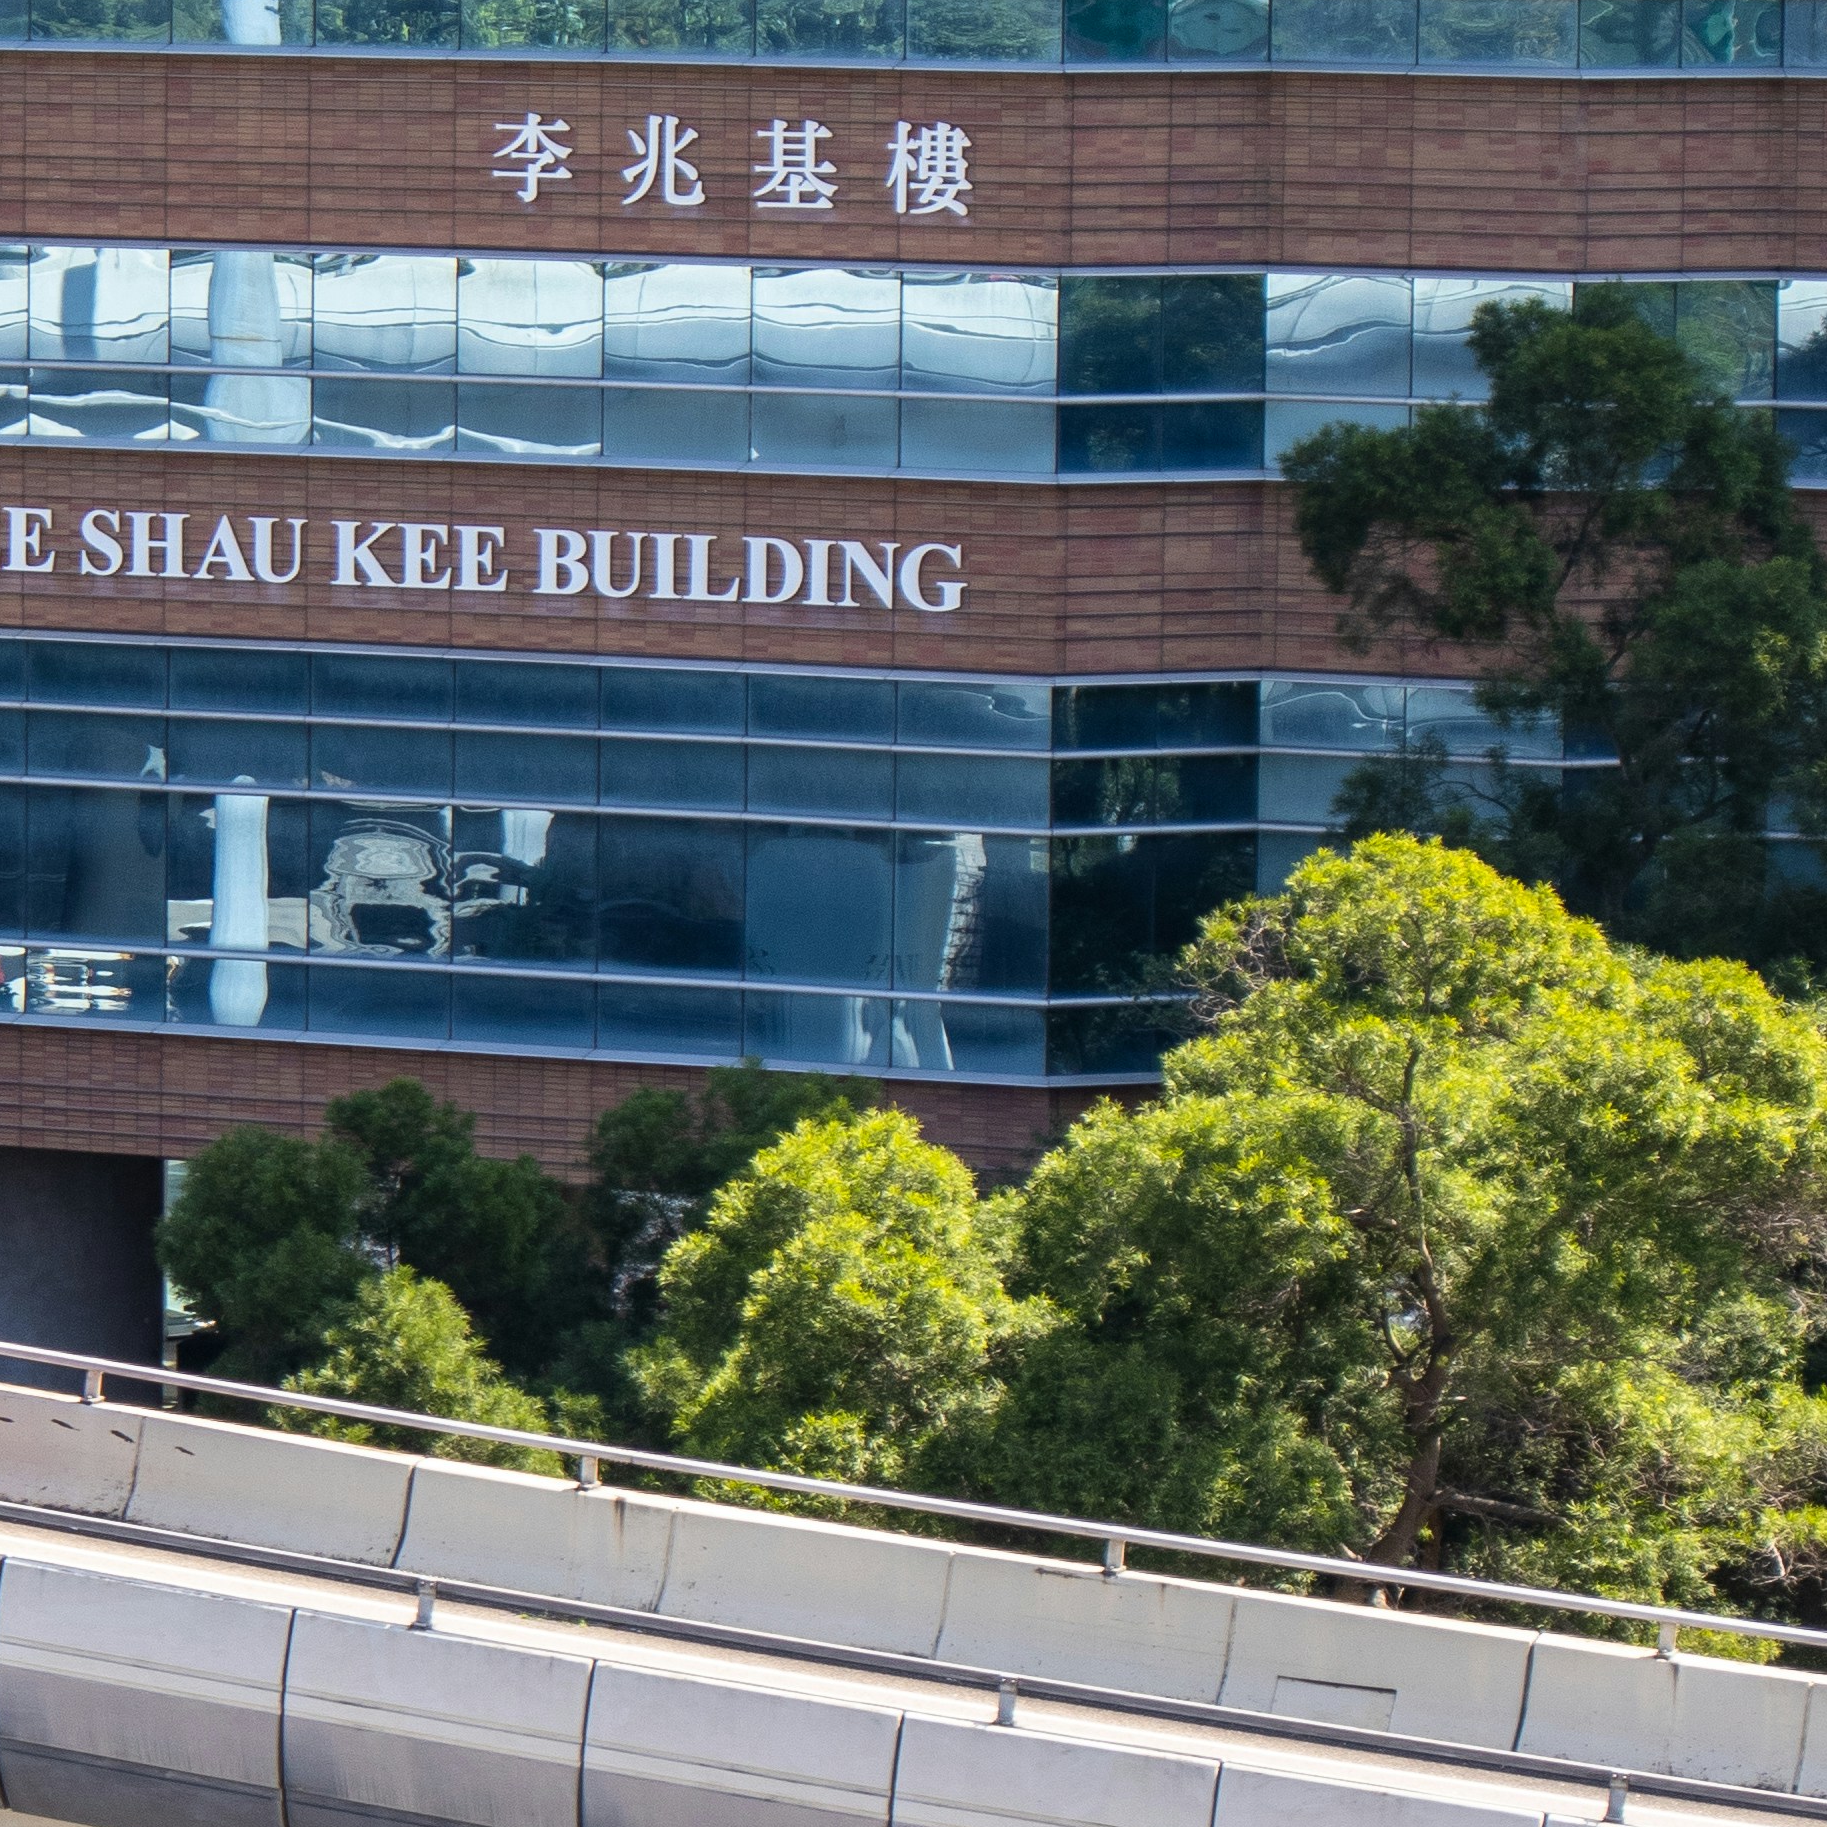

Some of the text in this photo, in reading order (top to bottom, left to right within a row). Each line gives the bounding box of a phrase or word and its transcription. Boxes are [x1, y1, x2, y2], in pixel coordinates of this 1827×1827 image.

[491, 112, 974, 217] 李兆基樓
[79, 509, 309, 584] SHAU
[329, 520, 509, 592] KEE
[532, 528, 969, 612] BUILDING
